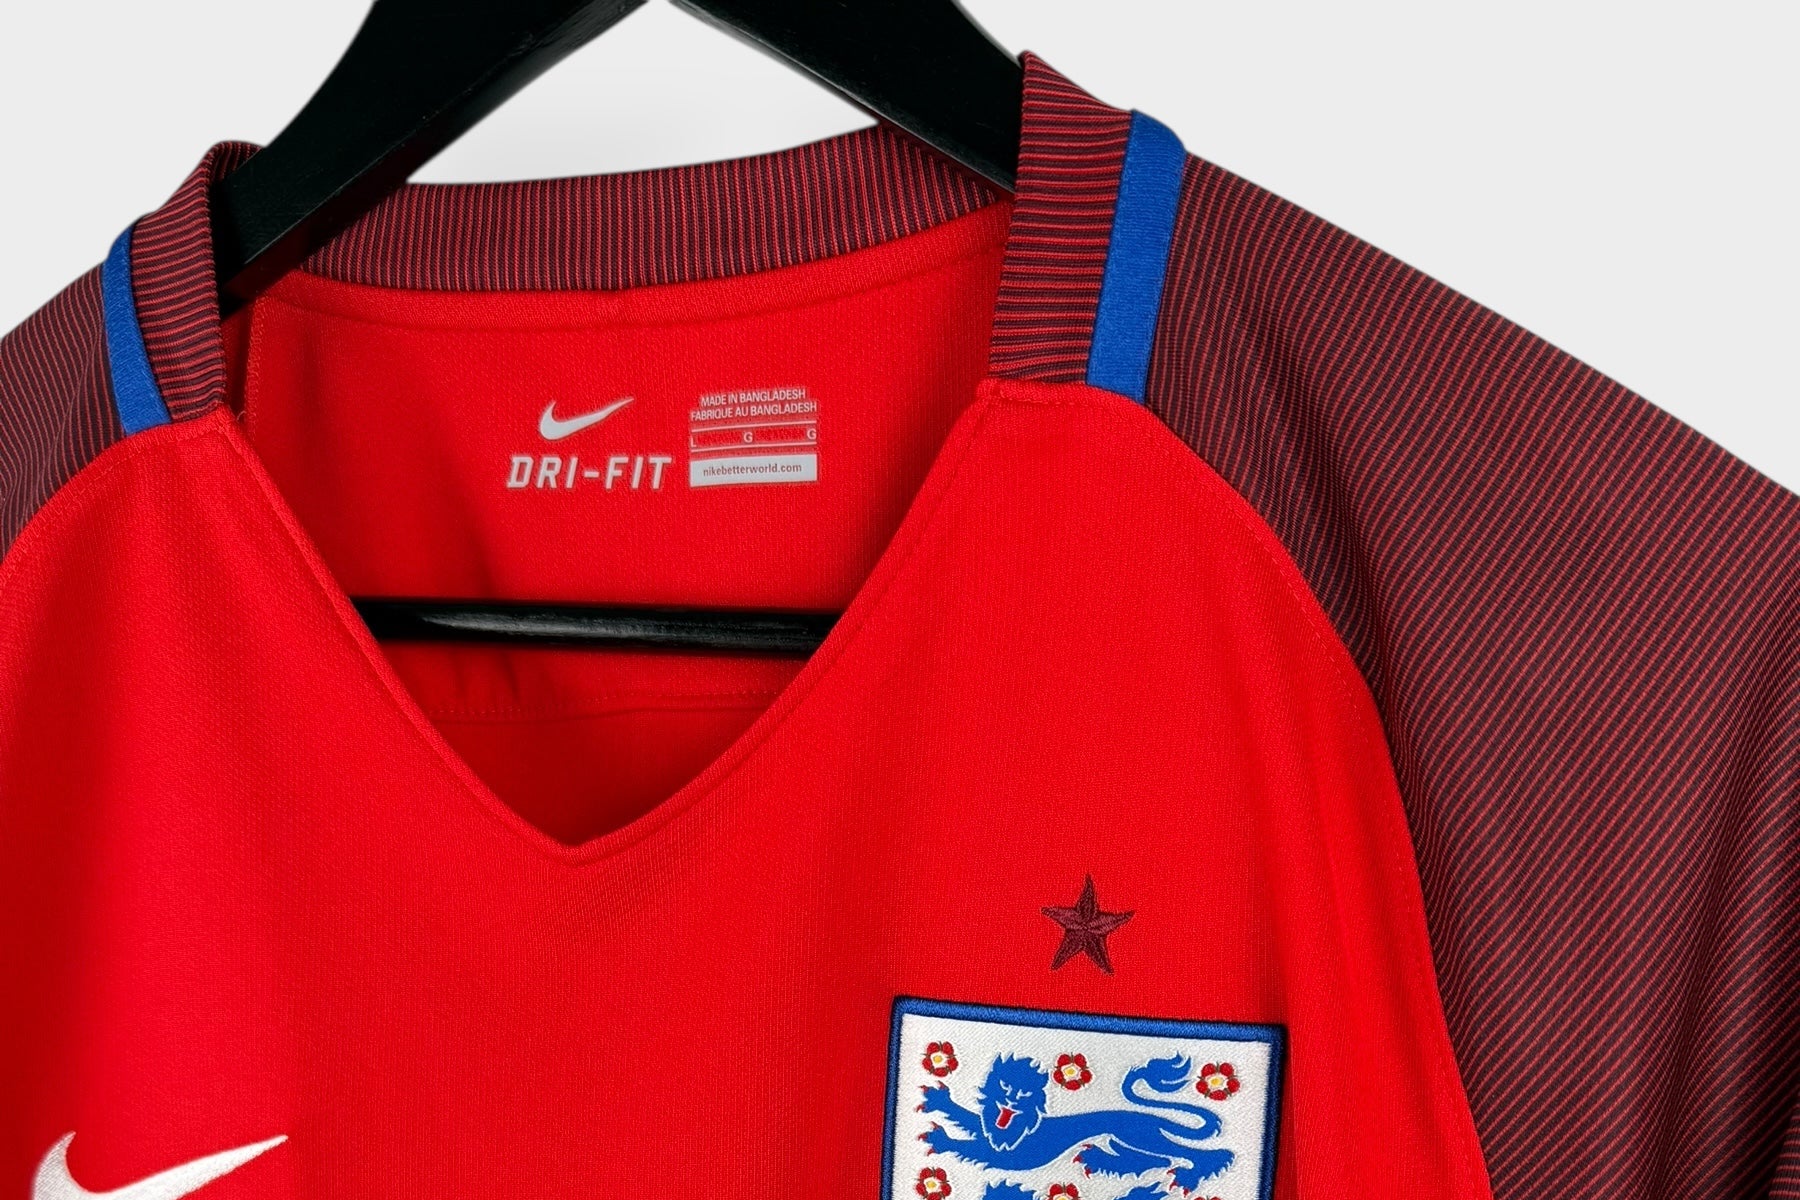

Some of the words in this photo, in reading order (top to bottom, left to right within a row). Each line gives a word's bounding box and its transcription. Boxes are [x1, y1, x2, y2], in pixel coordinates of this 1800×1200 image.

[701, 394, 727, 407] MADE
[728, 393, 738, 404] IN
[740, 388, 806, 403] BANGLADESH
[691, 408, 733, 421] FABRIQUE
[735, 407, 749, 417] AU
[750, 402, 817, 416] BANGLADESH
[690, 436, 697, 447] L
[743, 431, 753, 443] G
[807, 428, 817, 440] G
[506, 455, 673, 490] DRI-FIT
[703, 463, 802, 477] nikebetterworld.com
